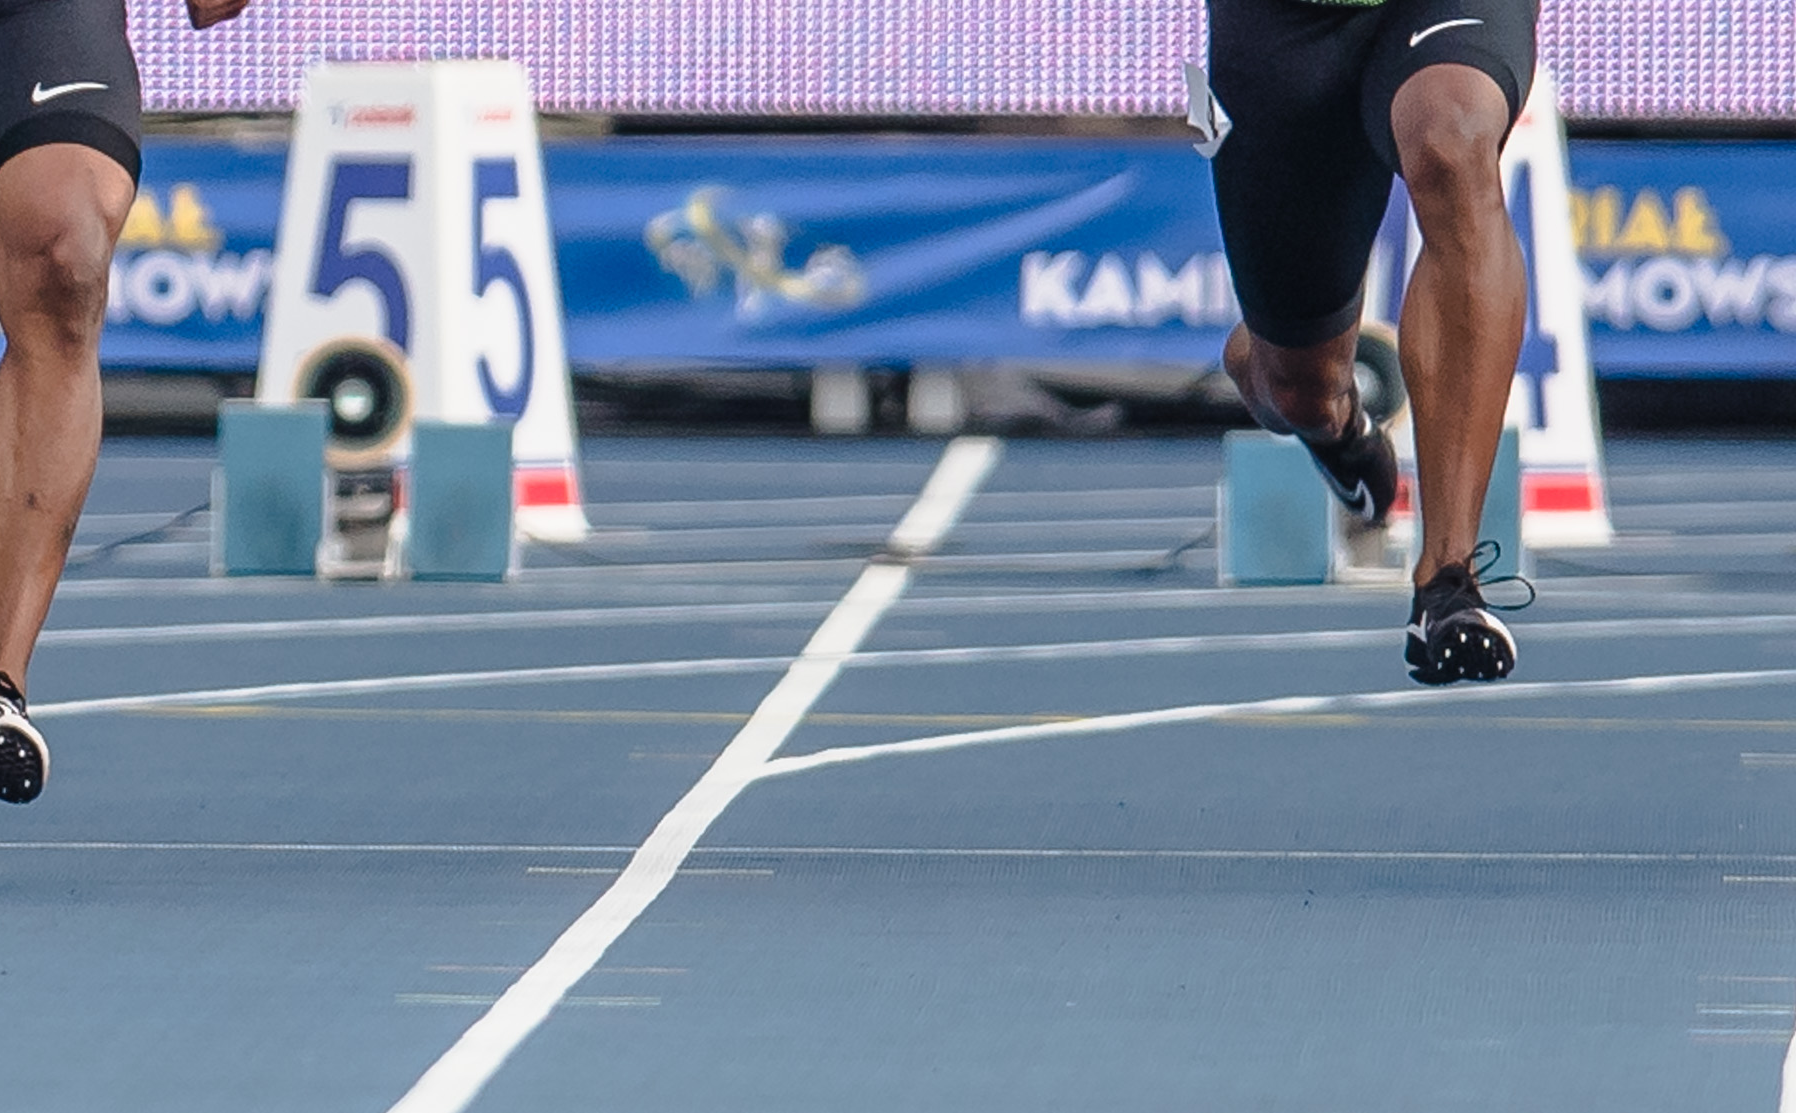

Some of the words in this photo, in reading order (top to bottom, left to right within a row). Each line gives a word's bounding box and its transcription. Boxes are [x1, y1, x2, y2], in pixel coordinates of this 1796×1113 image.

[308, 150, 415, 356] 5
[472, 156, 535, 420] 5
[1018, 250, 1242, 328] KAMI
